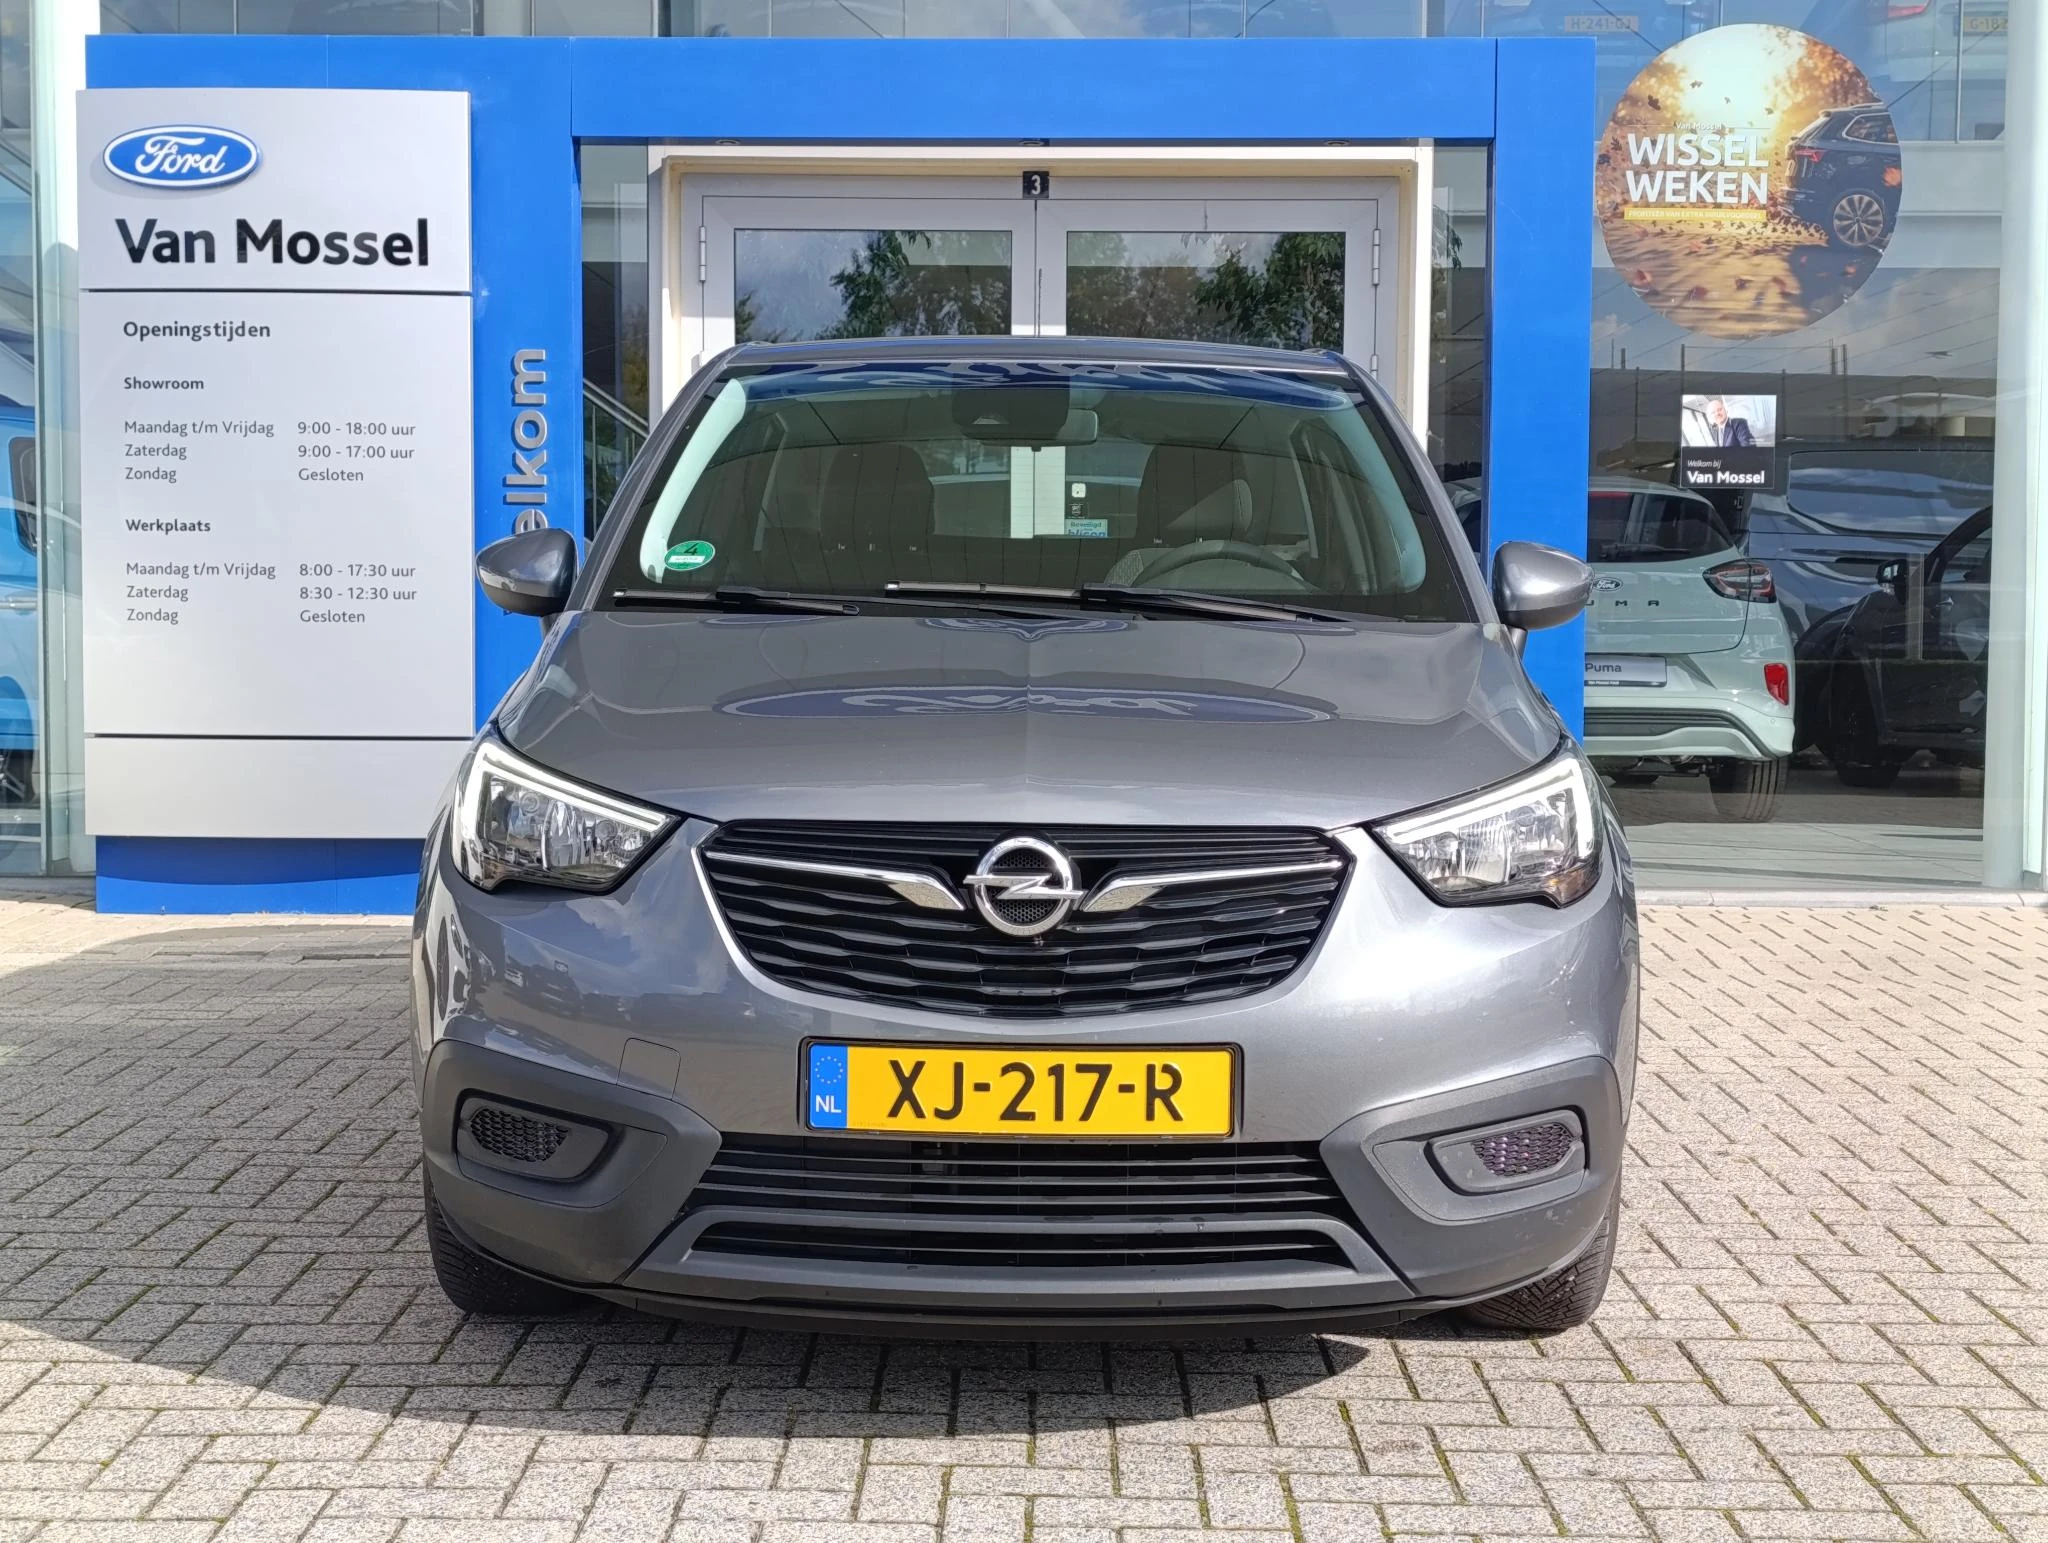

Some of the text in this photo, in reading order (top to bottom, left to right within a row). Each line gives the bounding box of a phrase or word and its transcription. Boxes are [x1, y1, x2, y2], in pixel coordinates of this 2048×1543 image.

[134, 134, 228, 175] Ford
[1627, 133, 1769, 167] WISSEL
[1031, 174, 1041, 195] 3
[1625, 169, 1768, 205] WEKEN
[114, 217, 429, 267] Van Mossel
[123, 320, 271, 343] Openingstijden
[123, 376, 205, 391] Showroom
[124, 419, 188, 438] Maandag
[192, 419, 218, 435] t/m
[222, 420, 275, 438] Vrijdag
[297, 421, 331, 436] 9:00
[345, 421, 387, 436] 18:00
[391, 424, 417, 437] uur
[503, 348, 548, 534] elkom
[124, 443, 188, 461] Zaterdag
[297, 445, 332, 459] 9:00
[345, 445, 386, 459] 17:00
[390, 448, 416, 460] uur
[1687, 460, 1713, 468] Welkom
[124, 466, 365, 484] Zondag Gesloten
[1687, 470, 1765, 484] Van Mossel
[125, 518, 212, 536] Werkplaats
[683, 542, 699, 556] 4
[126, 561, 190, 580] Maandag
[193, 561, 220, 577] t/m
[224, 562, 277, 581] Vrijdag
[299, 563, 333, 577] 8:00
[347, 563, 388, 578] 17:30
[391, 567, 417, 578] uur
[126, 585, 189, 603] Zaterdag
[299, 587, 333, 601] 8:30
[347, 587, 389, 601] 12:30
[392, 590, 418, 601] uur
[1585, 599, 1660, 607] UMA
[126, 608, 366, 626] Zondag Gesloten
[1585, 663, 1622, 673] Puma
[887, 1058, 1185, 1122] XJ-217-R
[815, 1094, 842, 1114] NL
